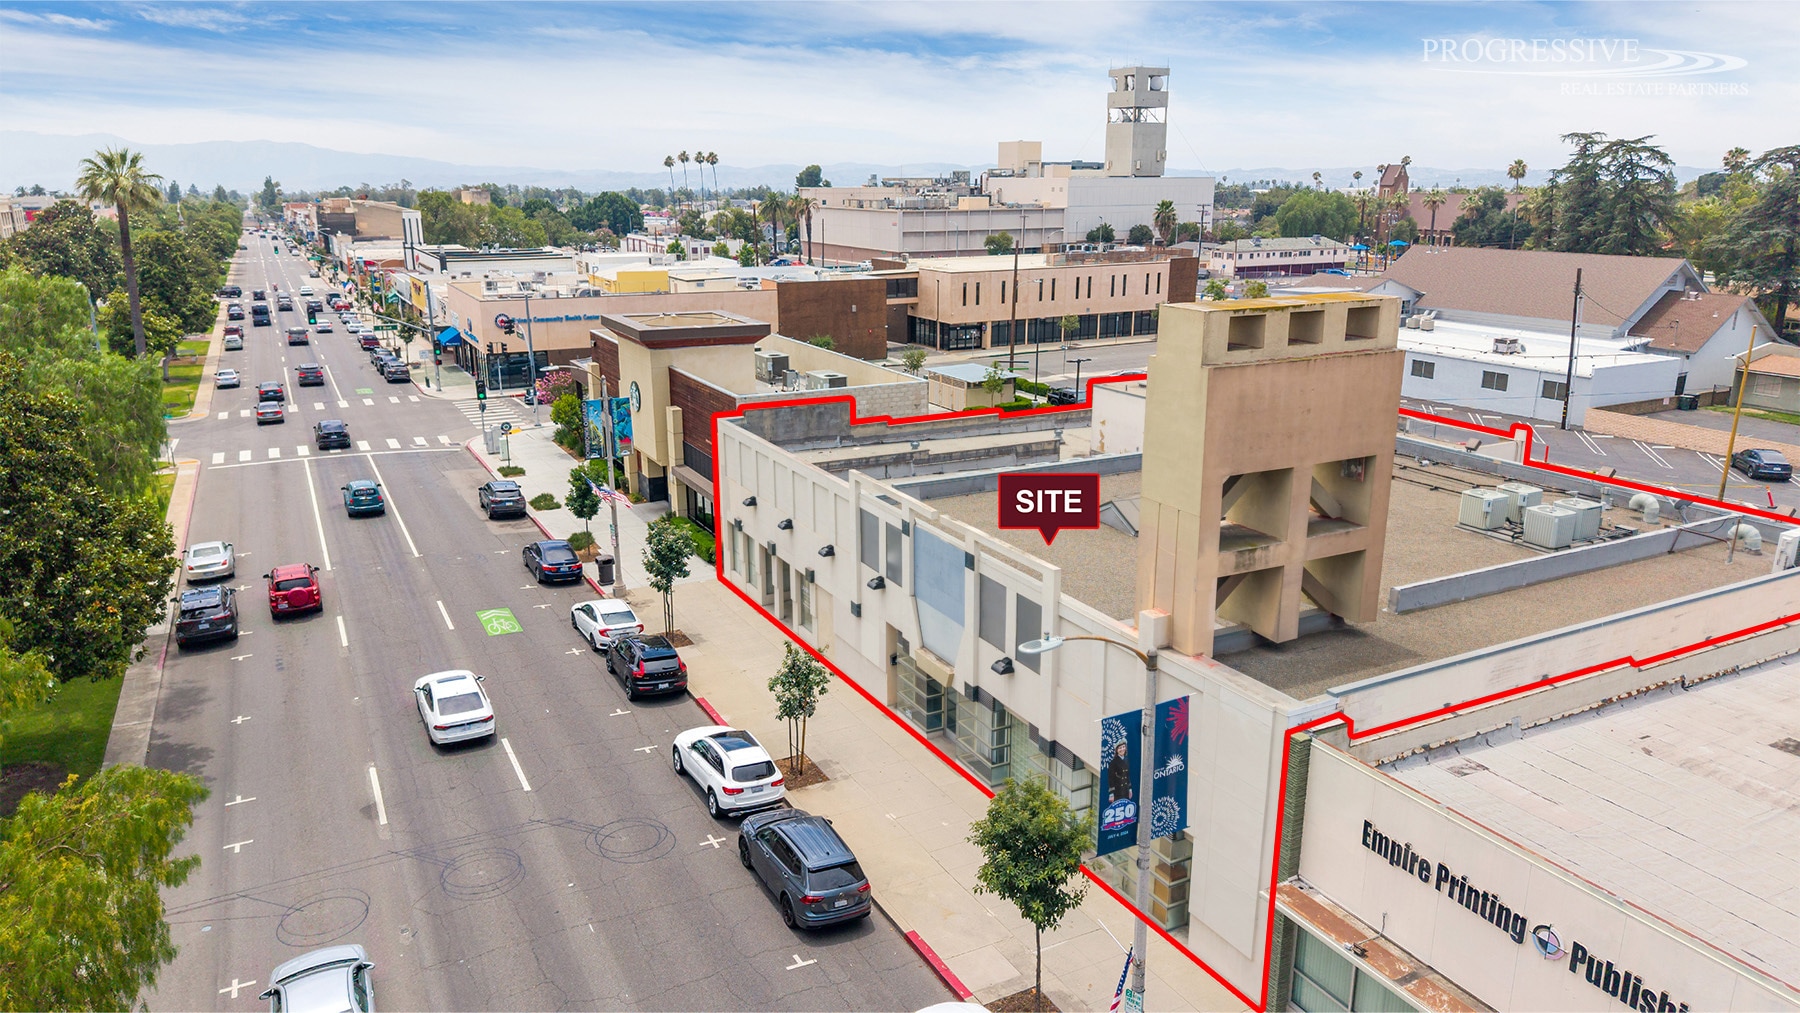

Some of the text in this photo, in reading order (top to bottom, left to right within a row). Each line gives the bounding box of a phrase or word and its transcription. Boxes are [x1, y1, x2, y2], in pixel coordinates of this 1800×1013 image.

[533, 315, 563, 323] Community
[582, 313, 600, 321] Center
[1153, 763, 1185, 780] ONTARIO
[1104, 804, 1135, 824] 250
[1361, 819, 1432, 883] Empire
[1434, 862, 1528, 944] Printing
